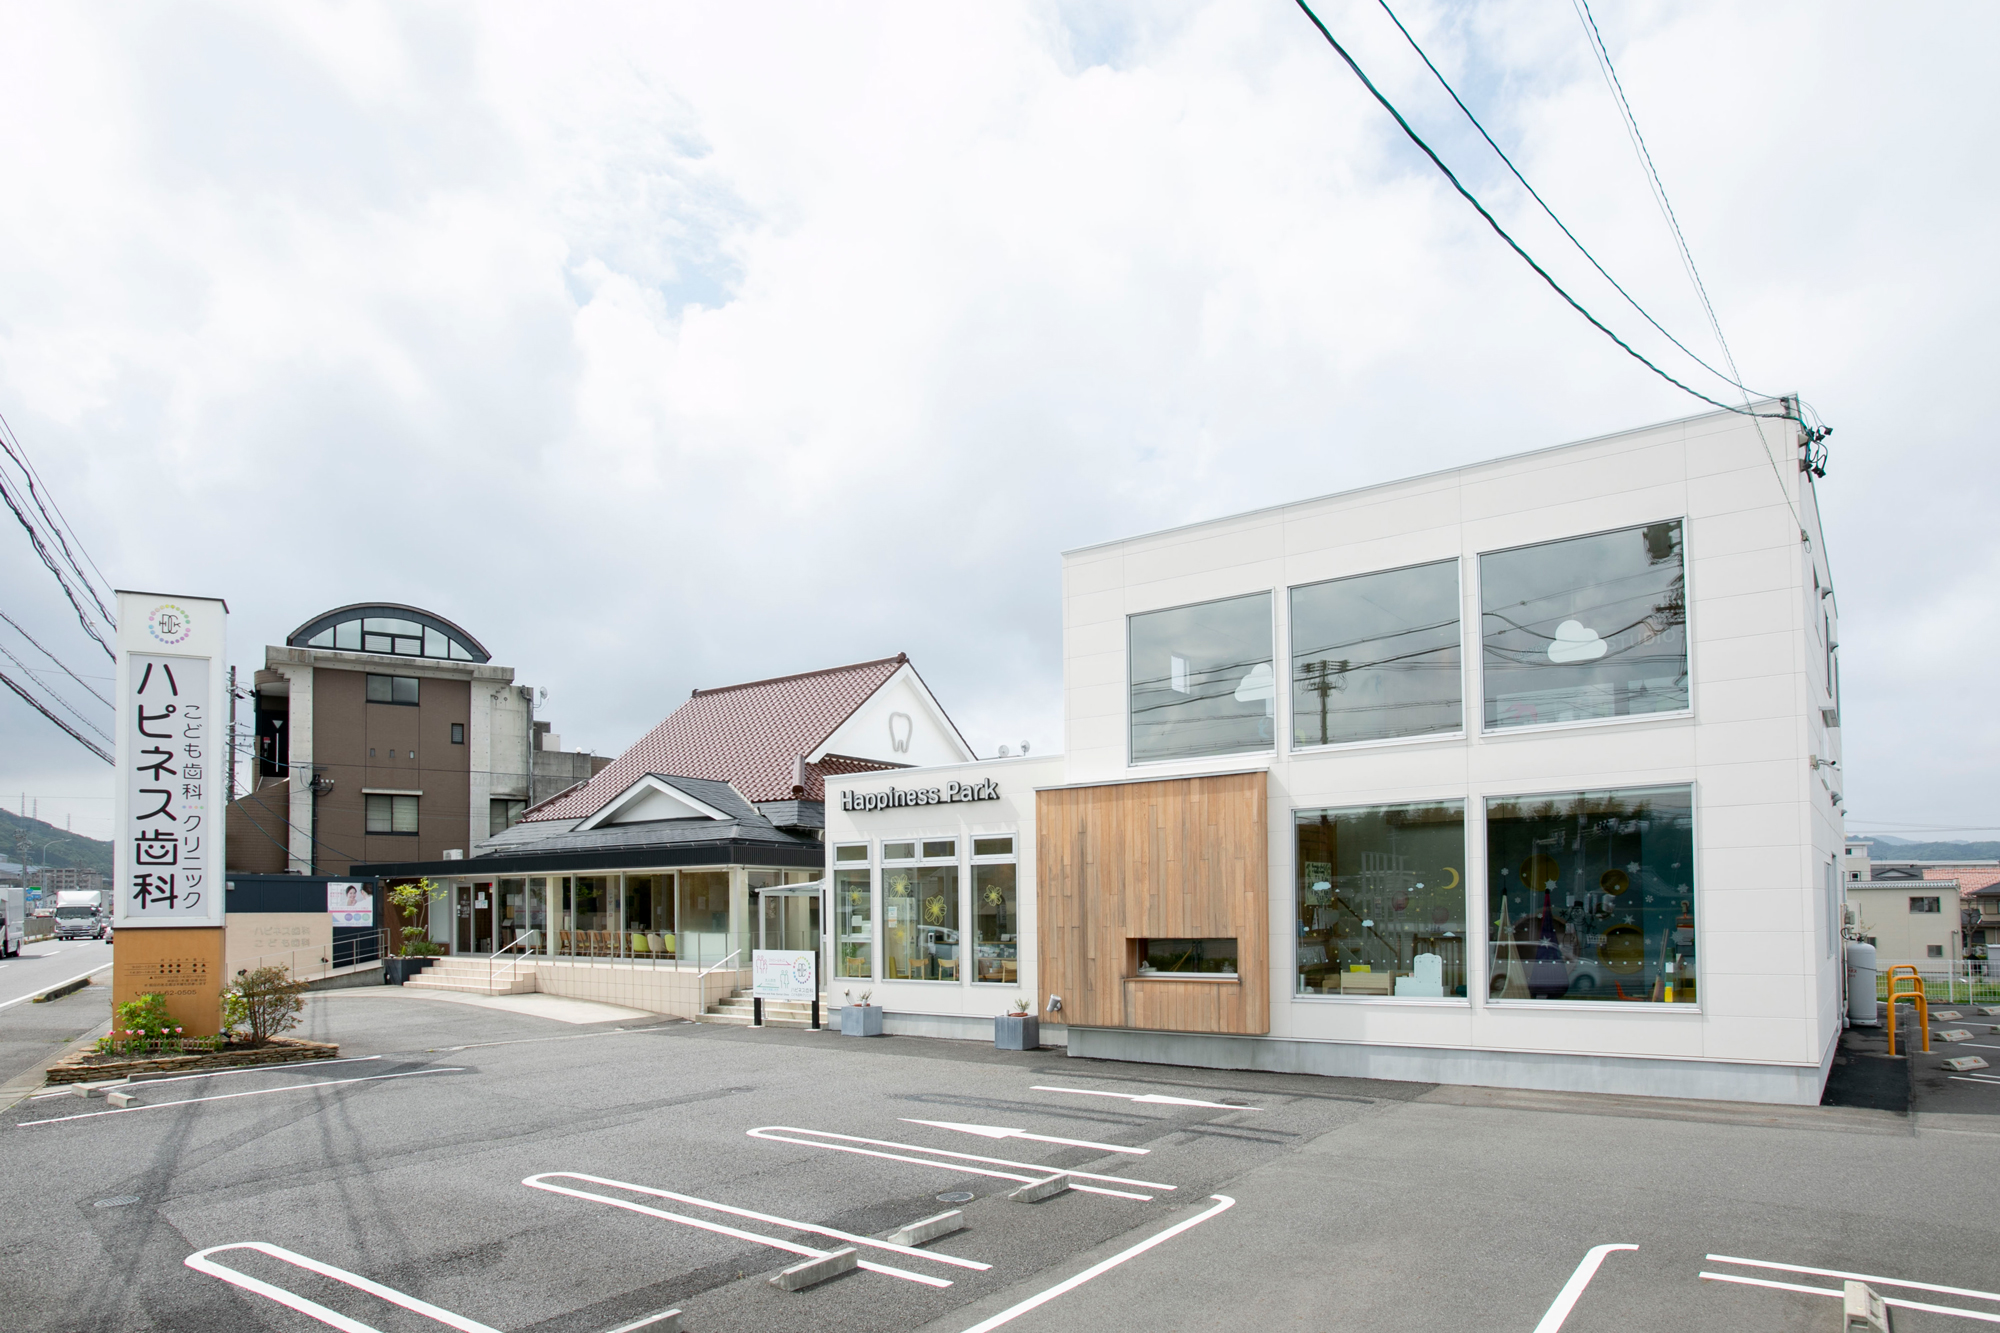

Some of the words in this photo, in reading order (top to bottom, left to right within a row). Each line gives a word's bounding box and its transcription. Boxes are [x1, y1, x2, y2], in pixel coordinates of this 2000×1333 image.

[133, 662, 179, 910] ハピネス歯科
[182, 704, 203, 801] こども歯科
[840, 786, 941, 812] Happiness
[946, 777, 1000, 803] Park
[182, 815, 203, 909] クリニック
